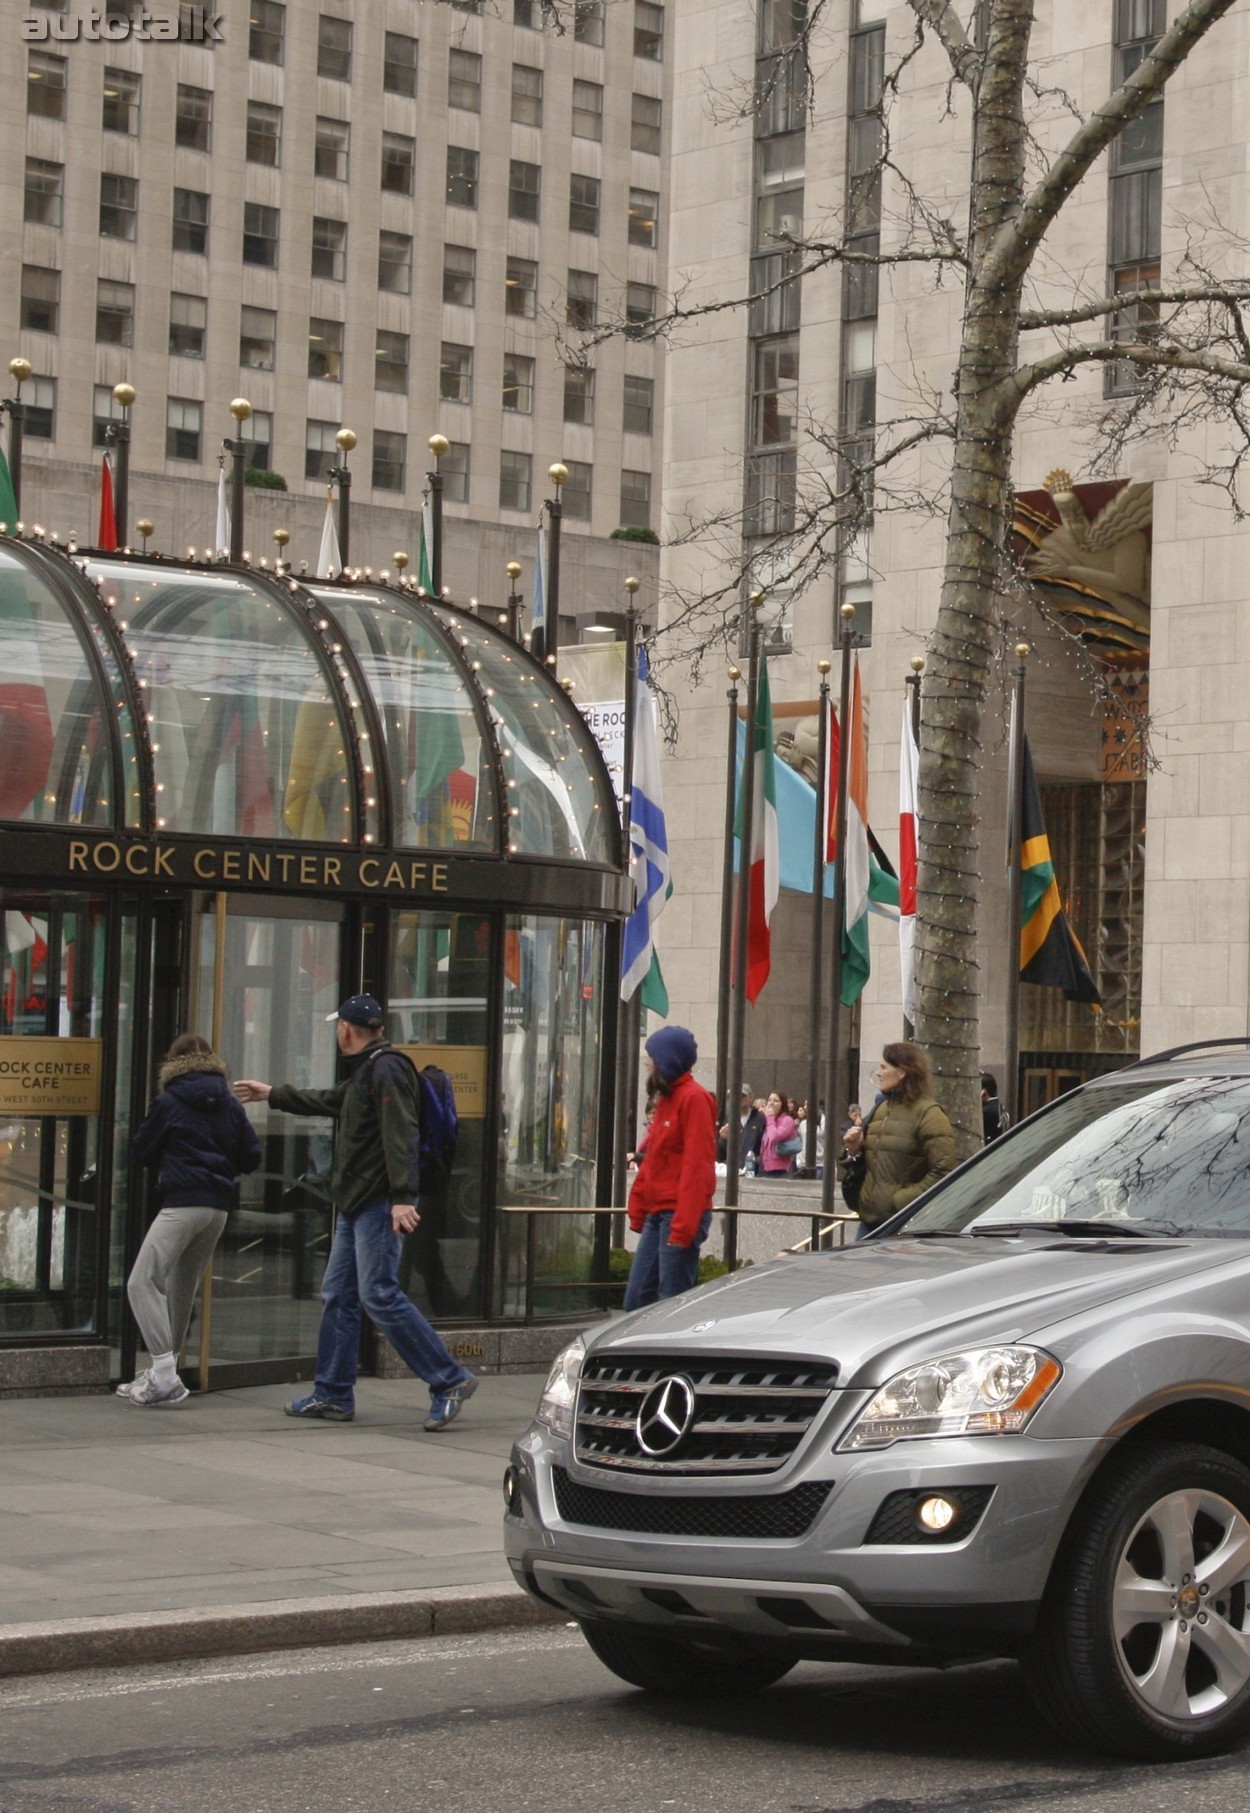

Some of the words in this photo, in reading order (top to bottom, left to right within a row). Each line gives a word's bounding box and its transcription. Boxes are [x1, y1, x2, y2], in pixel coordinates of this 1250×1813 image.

[69, 841, 176, 876] ROCK
[194, 849, 341, 885] CENTER
[359, 858, 448, 891] CAFE
[0, 1061, 30, 1074] OCK
[35, 1062, 91, 1075] CENTER
[454, 1086, 478, 1094] ENTER
[4, 1095, 28, 1104] WEST
[56, 1095, 88, 1105] STREET
[456, 1342, 485, 1357] 50th
